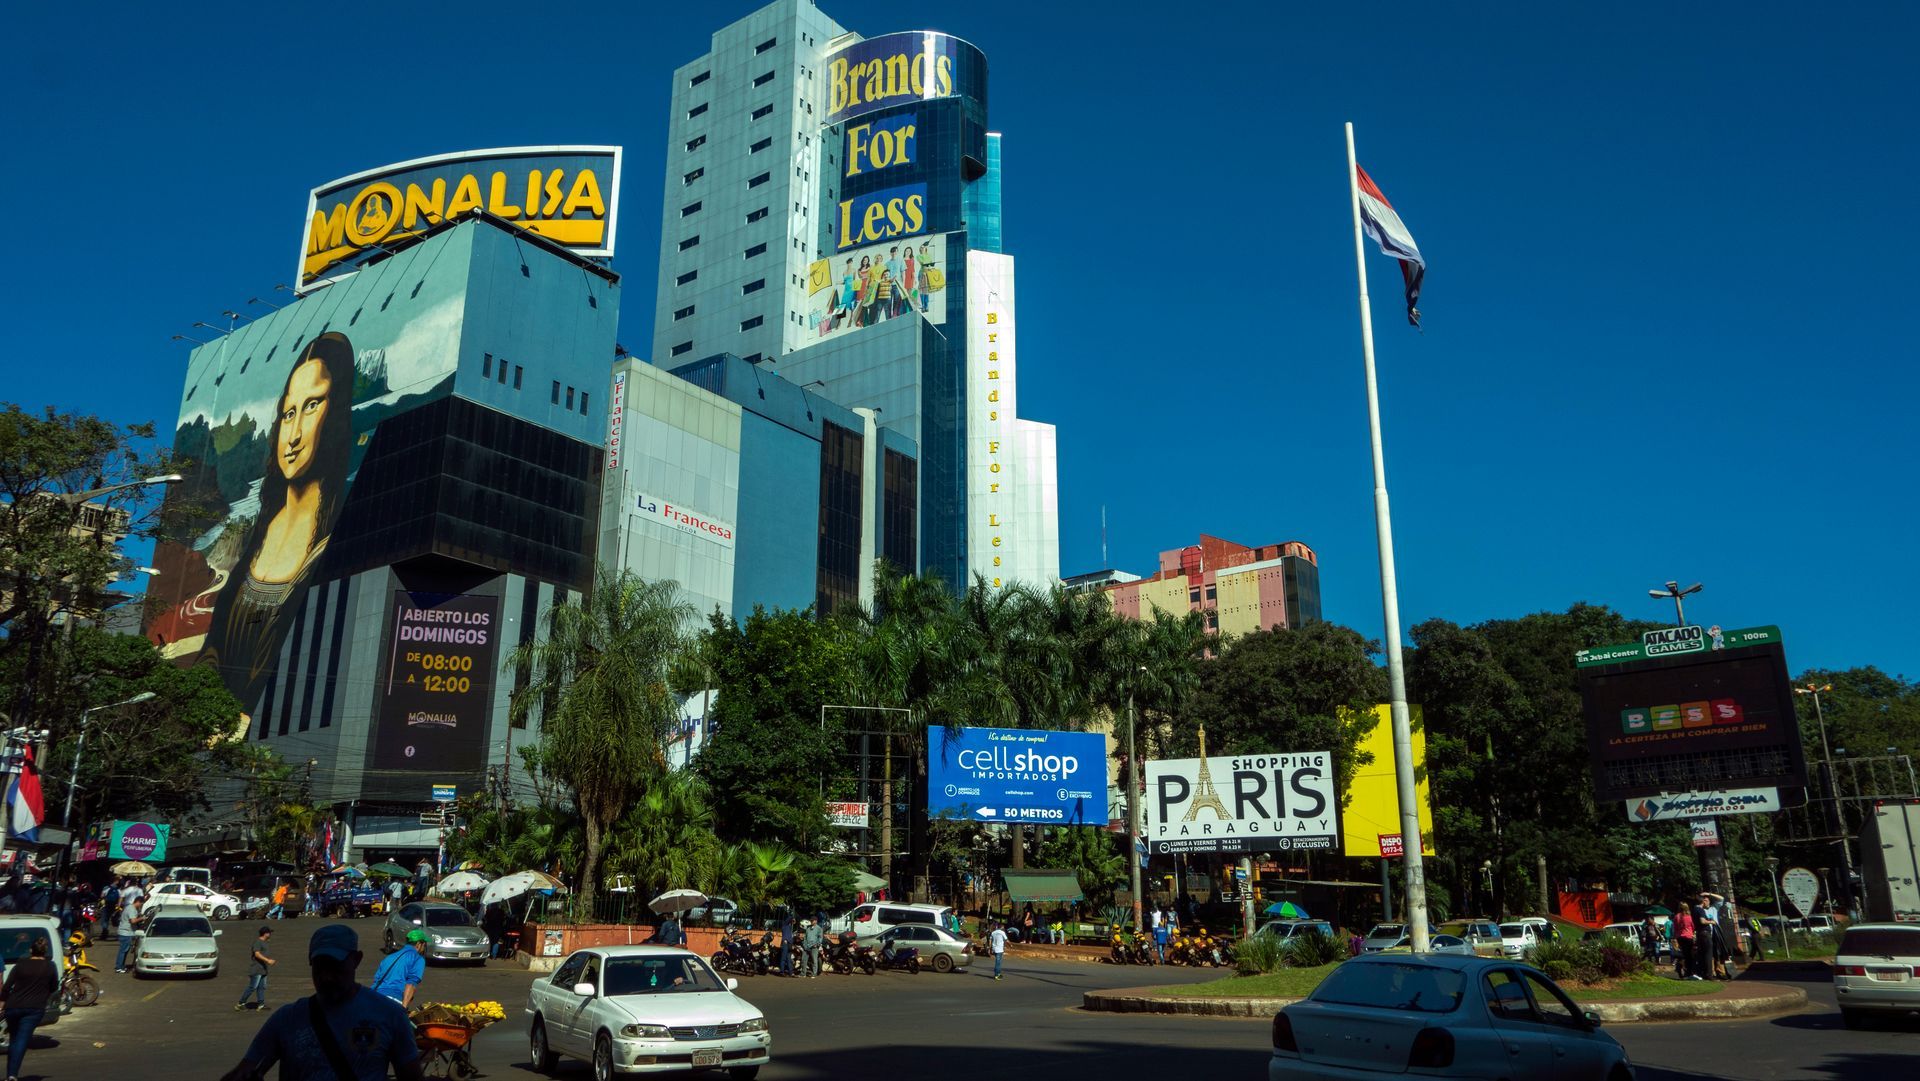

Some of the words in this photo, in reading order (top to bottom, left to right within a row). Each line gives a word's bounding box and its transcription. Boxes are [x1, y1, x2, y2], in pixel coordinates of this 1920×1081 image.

[827, 39, 952, 117] Brands
[846, 123, 916, 178] For
[305, 168, 606, 256] MONALISA
[837, 193, 924, 249] Less
[986, 312, 999, 421] Brands
[608, 384, 624, 470] Francesa
[988, 441, 1001, 493] For
[637, 495, 657, 513] La
[663, 504, 732, 539] Francesa
[989, 514, 1002, 588] Less
[404, 608, 462, 624] ABIERTO
[464, 612, 490, 625] LOS
[400, 625, 487, 645] DOMINGOS
[1645, 627, 1701, 645] ATACADO
[1743, 631, 1769, 641] 100m
[1648, 641, 1702, 655] GAMES
[406, 652, 421, 663] DE
[422, 654, 473, 672] 08:00
[407, 673, 416, 684] A
[423, 675, 470, 693] 12:00
[408, 711, 457, 722] MONALISA
[1609, 737, 1622, 745] LA
[1624, 733, 1669, 744] CERTEZA
[1671, 731, 1685, 739] EN
[1687, 726, 1739, 737] COMPRAR
[1742, 723, 1767, 732] BIEN
[958, 746, 1079, 780] cellshop
[1232, 756, 1324, 771] SHOPPING
[972, 771, 1057, 781] IMPORTADOS
[1684, 804, 1746, 814] IMPORTADOS
[1727, 794, 1768, 806] CHINA
[1004, 808, 1018, 818] 50
[1020, 808, 1063, 819] METROS
[1159, 820, 1328, 836] PARAGUAY
[122, 836, 157, 846] CHARME
[1293, 841, 1330, 849] EXCLUSIVO
